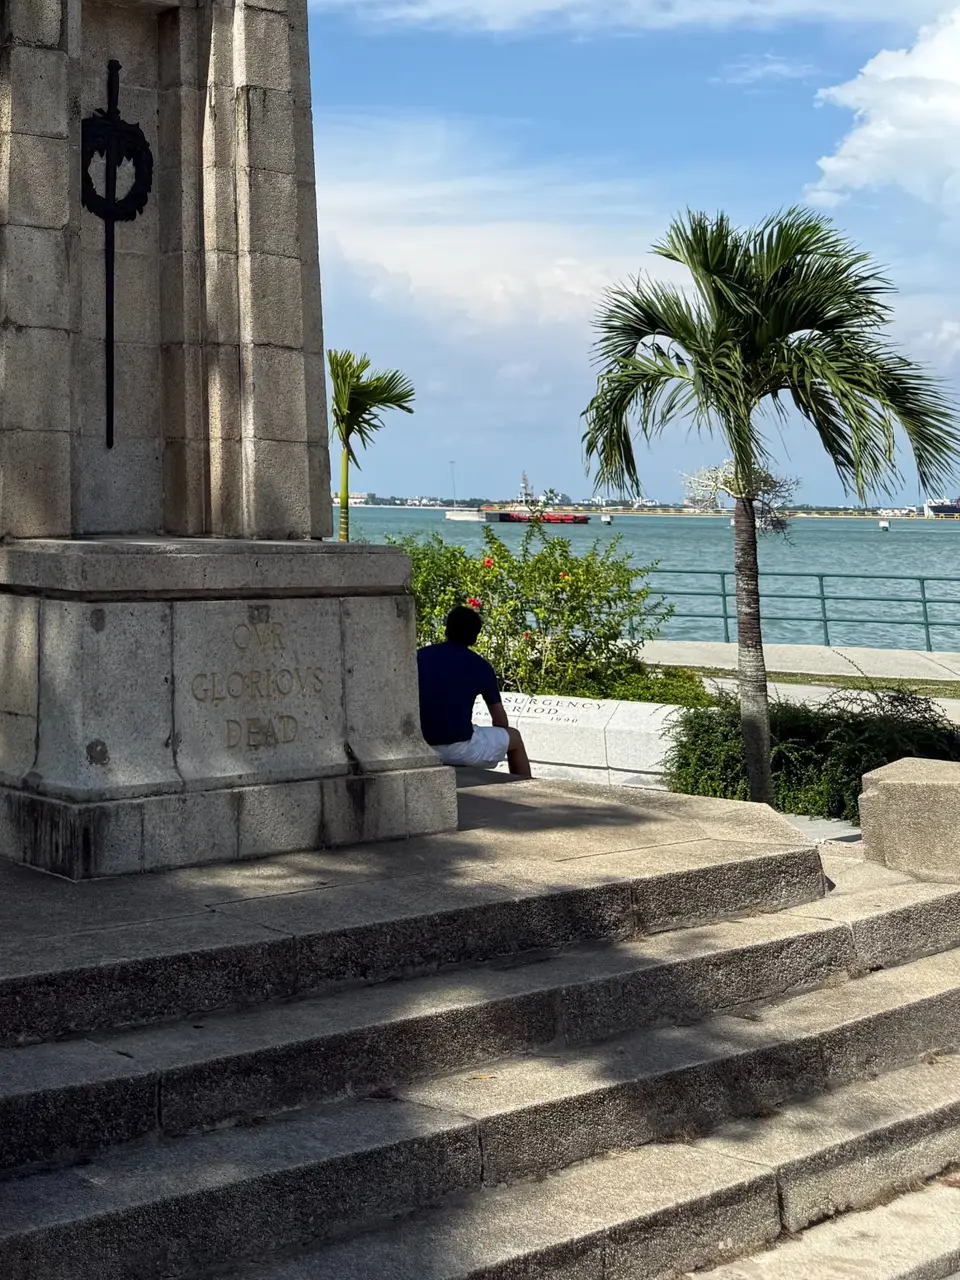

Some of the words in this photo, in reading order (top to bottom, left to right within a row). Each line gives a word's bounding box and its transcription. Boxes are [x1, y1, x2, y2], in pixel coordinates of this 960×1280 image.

[503, 696, 606, 710] SURGENCY
[504, 704, 559, 715] ERIOD
[226, 715, 299, 750] DEAD
